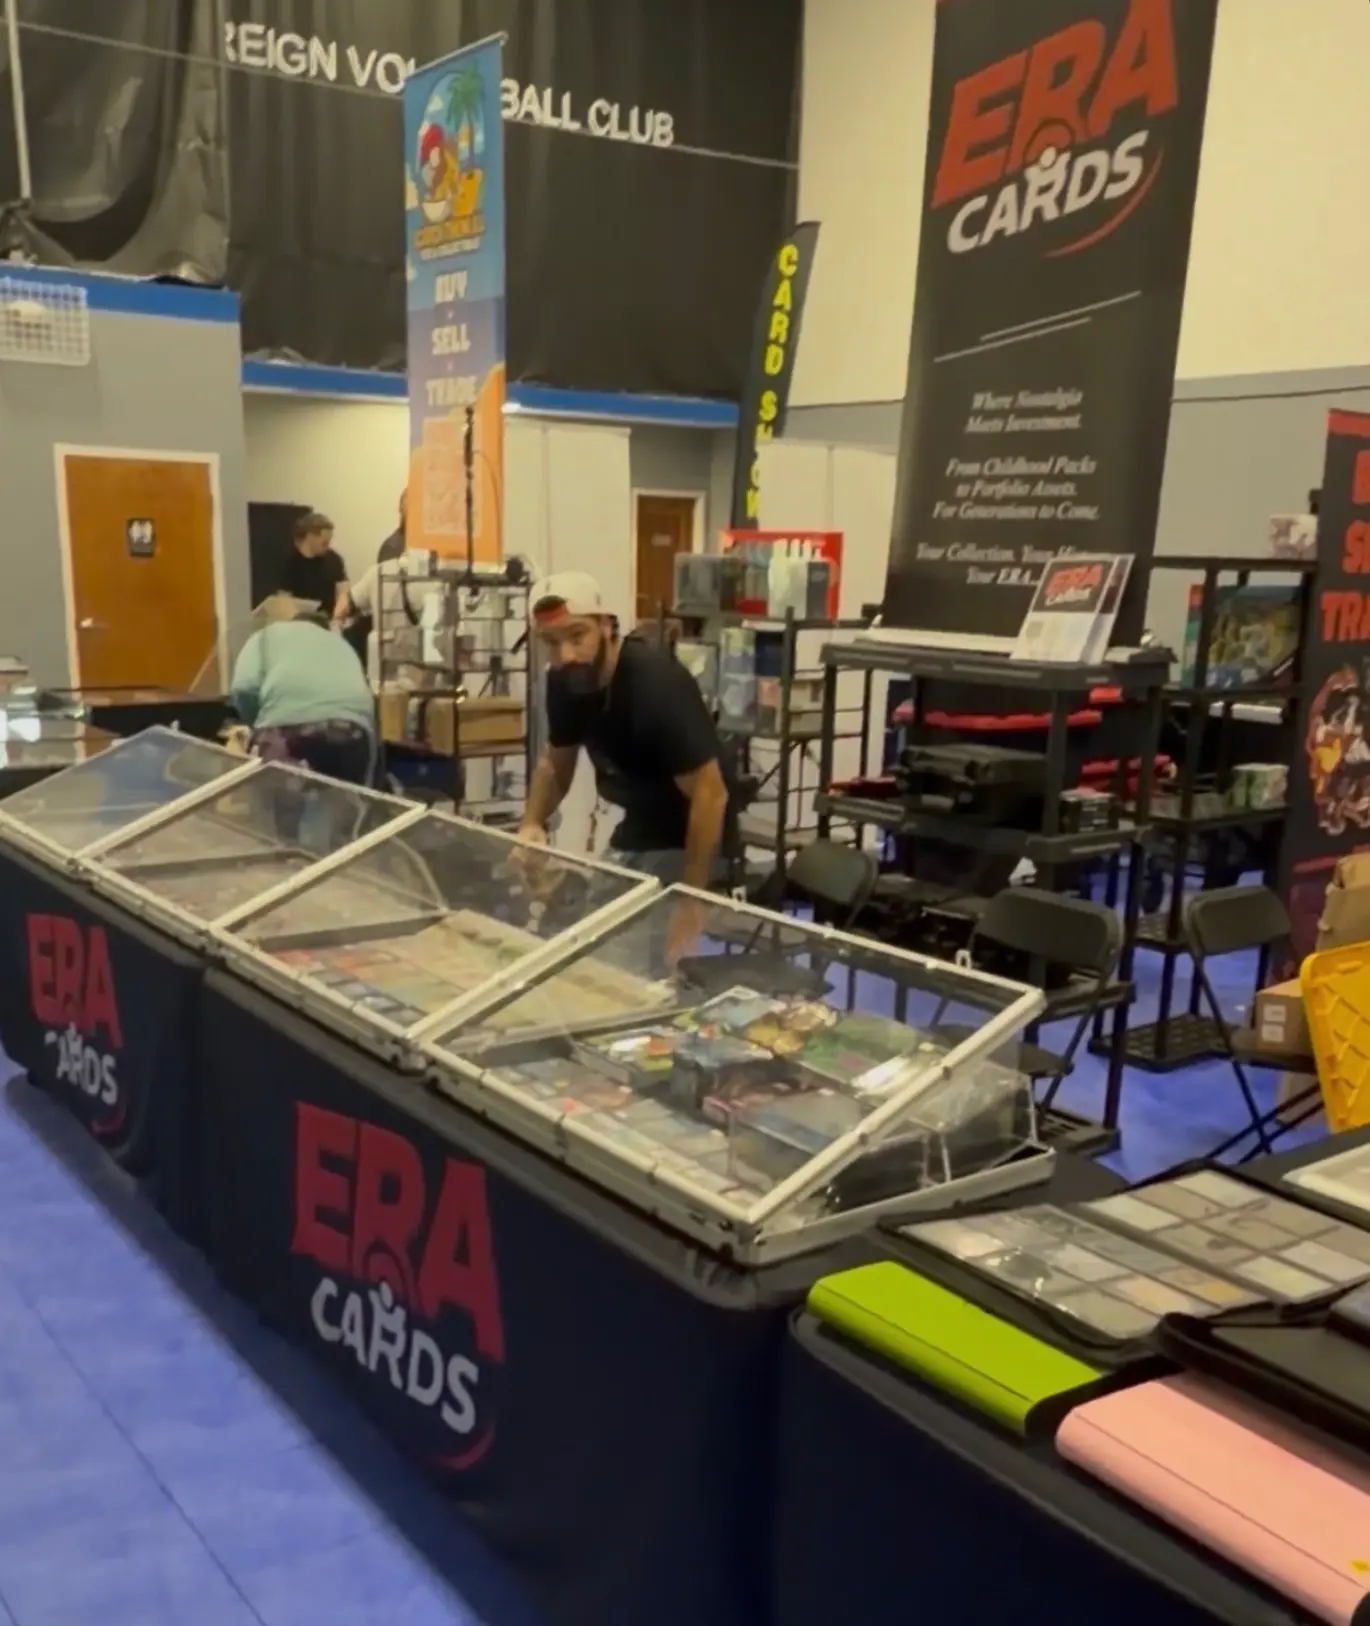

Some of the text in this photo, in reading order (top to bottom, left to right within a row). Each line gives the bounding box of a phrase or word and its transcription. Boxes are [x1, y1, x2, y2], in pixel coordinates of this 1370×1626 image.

[587, 97, 675, 148] CLUB
[931, 0, 1178, 210] ERA
[947, 130, 1149, 254] CARDS
[431, 322, 472, 356] SELL
[764, 243, 799, 375] CARD
[945, 457, 981, 477] From
[27, 912, 124, 1049] ERA
[290, 1100, 506, 1363] ERA
[311, 1277, 479, 1435] CARDS
